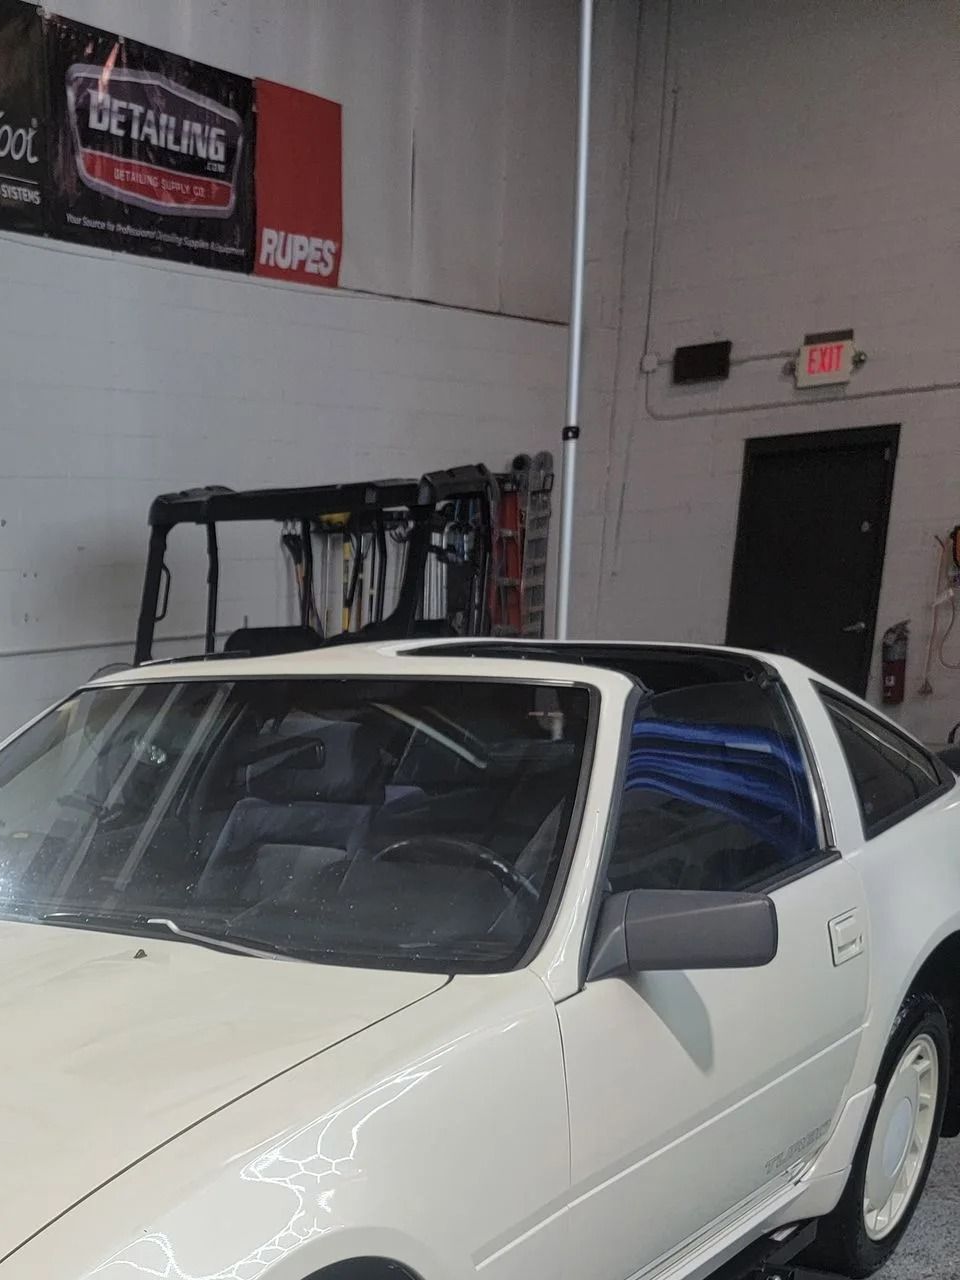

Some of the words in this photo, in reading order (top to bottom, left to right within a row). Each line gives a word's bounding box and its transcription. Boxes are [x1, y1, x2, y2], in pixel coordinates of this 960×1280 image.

[88, 89, 226, 162] DETAILING
[1, 184, 41, 205] SYSTEMS
[113, 167, 159, 188] DETAILING
[161, 178, 191, 195] SUPPLY
[66, 213, 82, 225] Your
[82, 216, 106, 230] Source
[259, 227, 337, 277] RUPES
[806, 344, 844, 375] EXIT
